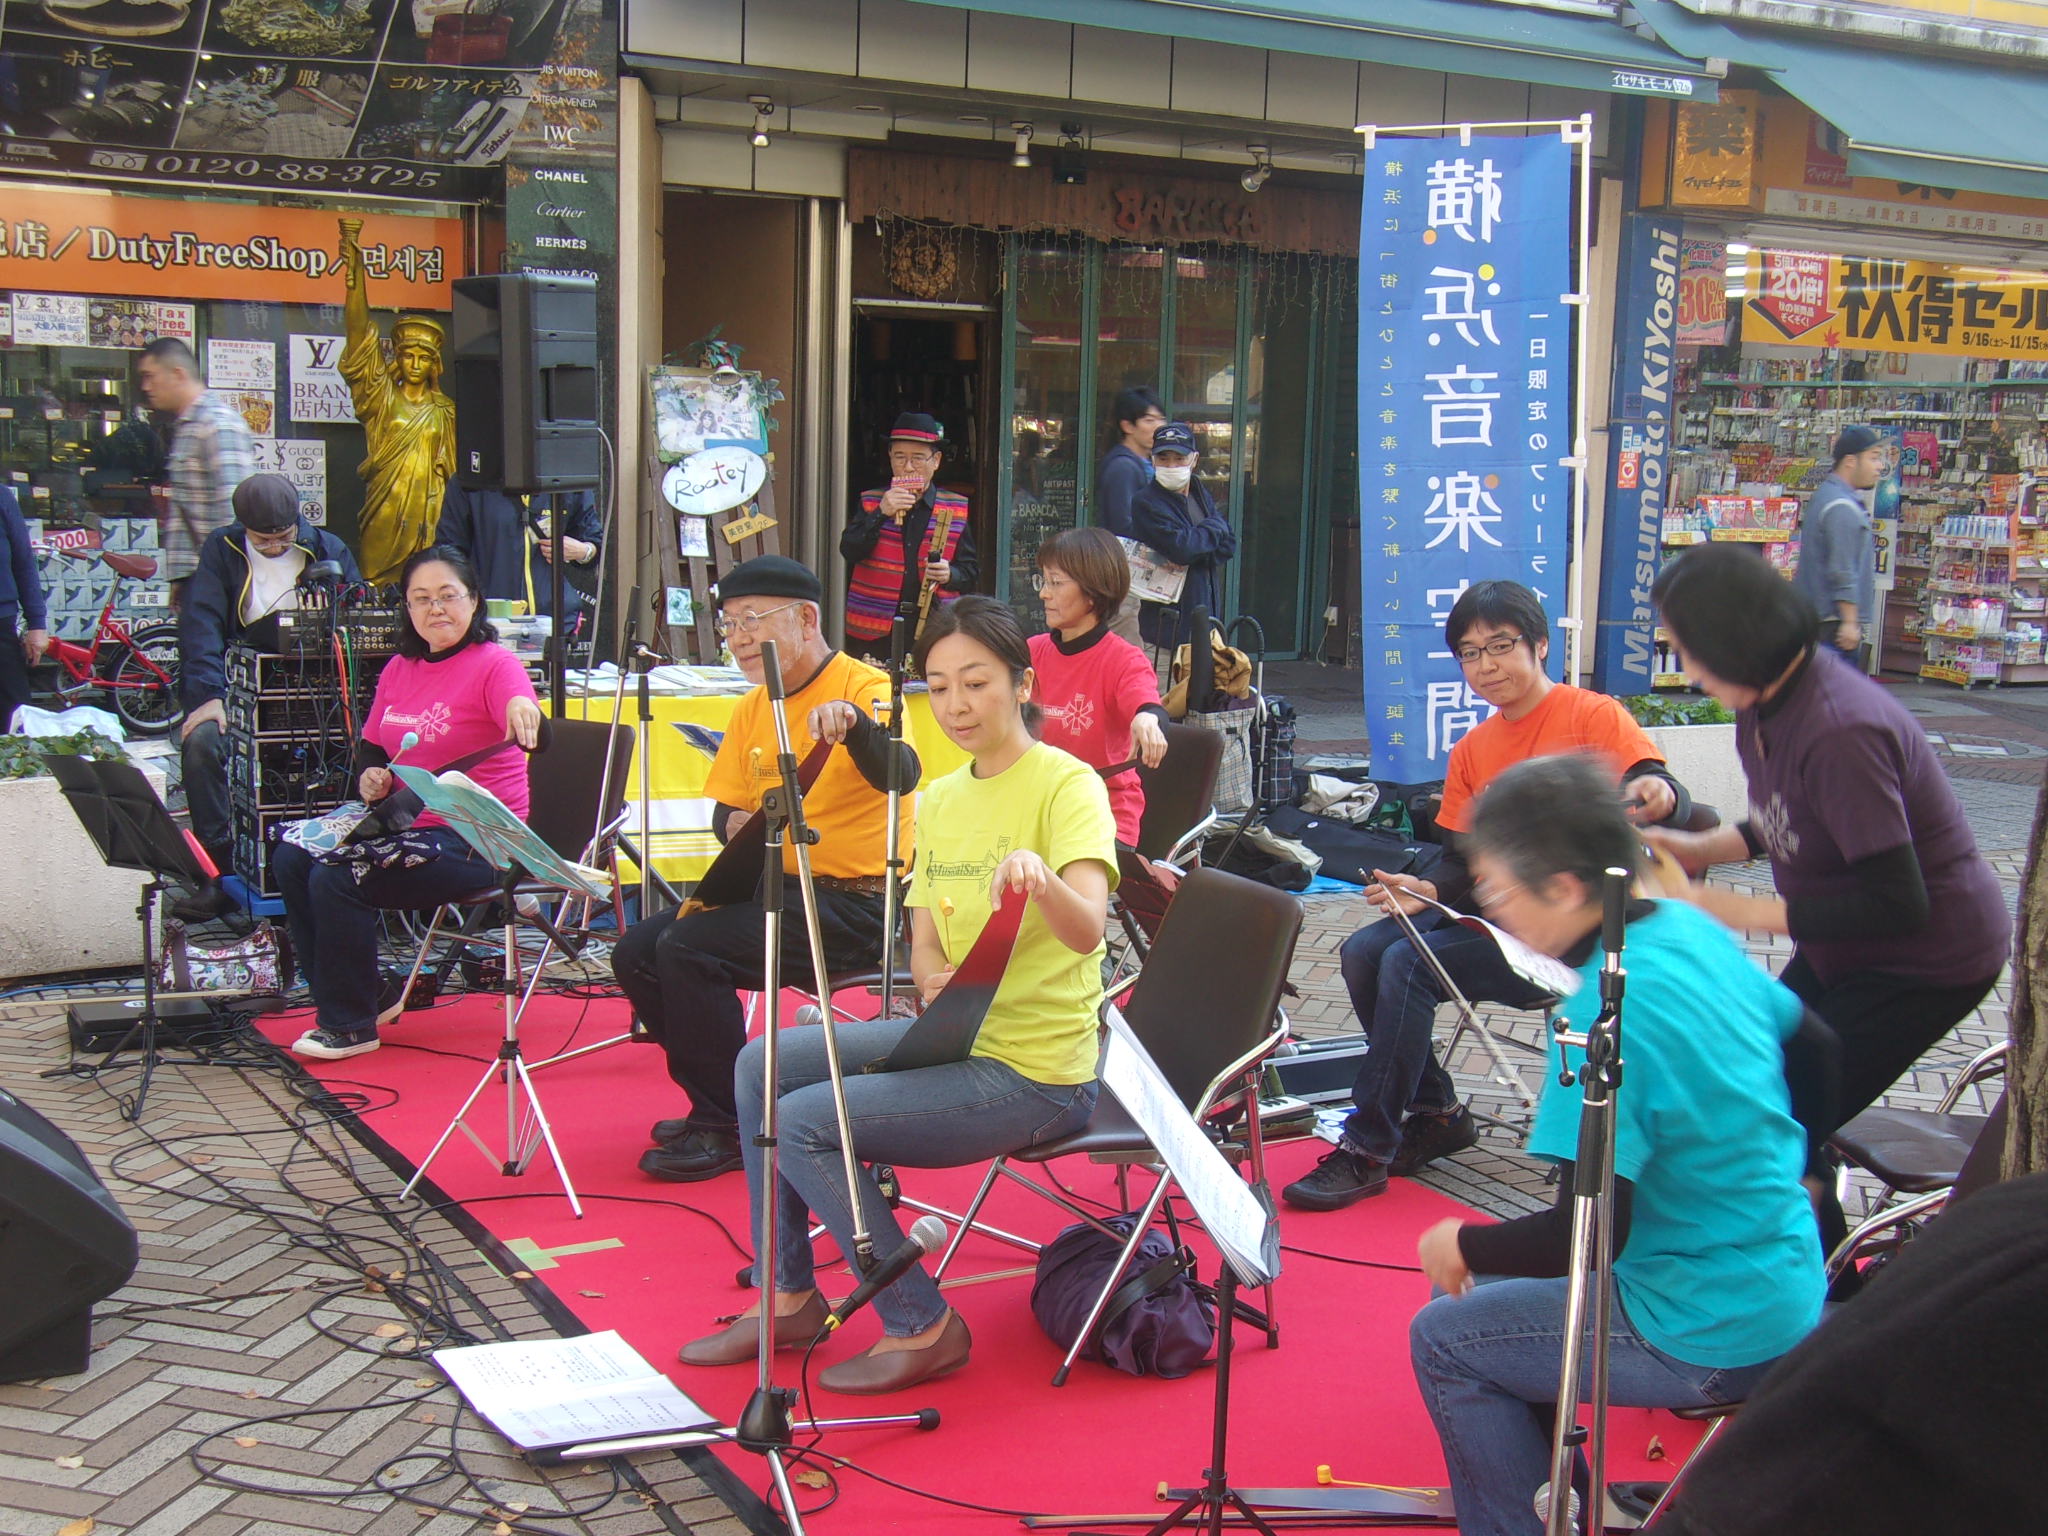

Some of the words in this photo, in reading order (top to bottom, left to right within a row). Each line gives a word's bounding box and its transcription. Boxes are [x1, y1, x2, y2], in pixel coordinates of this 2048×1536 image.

[64, 50, 134, 70] ホビー
[556, 66, 598, 78] VUITTON
[390, 75, 522, 96] ゴルフアイテム
[1613, 74, 1673, 90] イセザキモール
[544, 125, 580, 143] IWC
[155, 154, 442, 190] 0120-88-3725
[535, 170, 588, 184] CHANEL
[537, 201, 586, 218] Cartier
[362, 244, 444, 283] 면세점
[289, 447, 324, 457] GUCCI
[1622, 410, 1667, 676] Matsumoto
